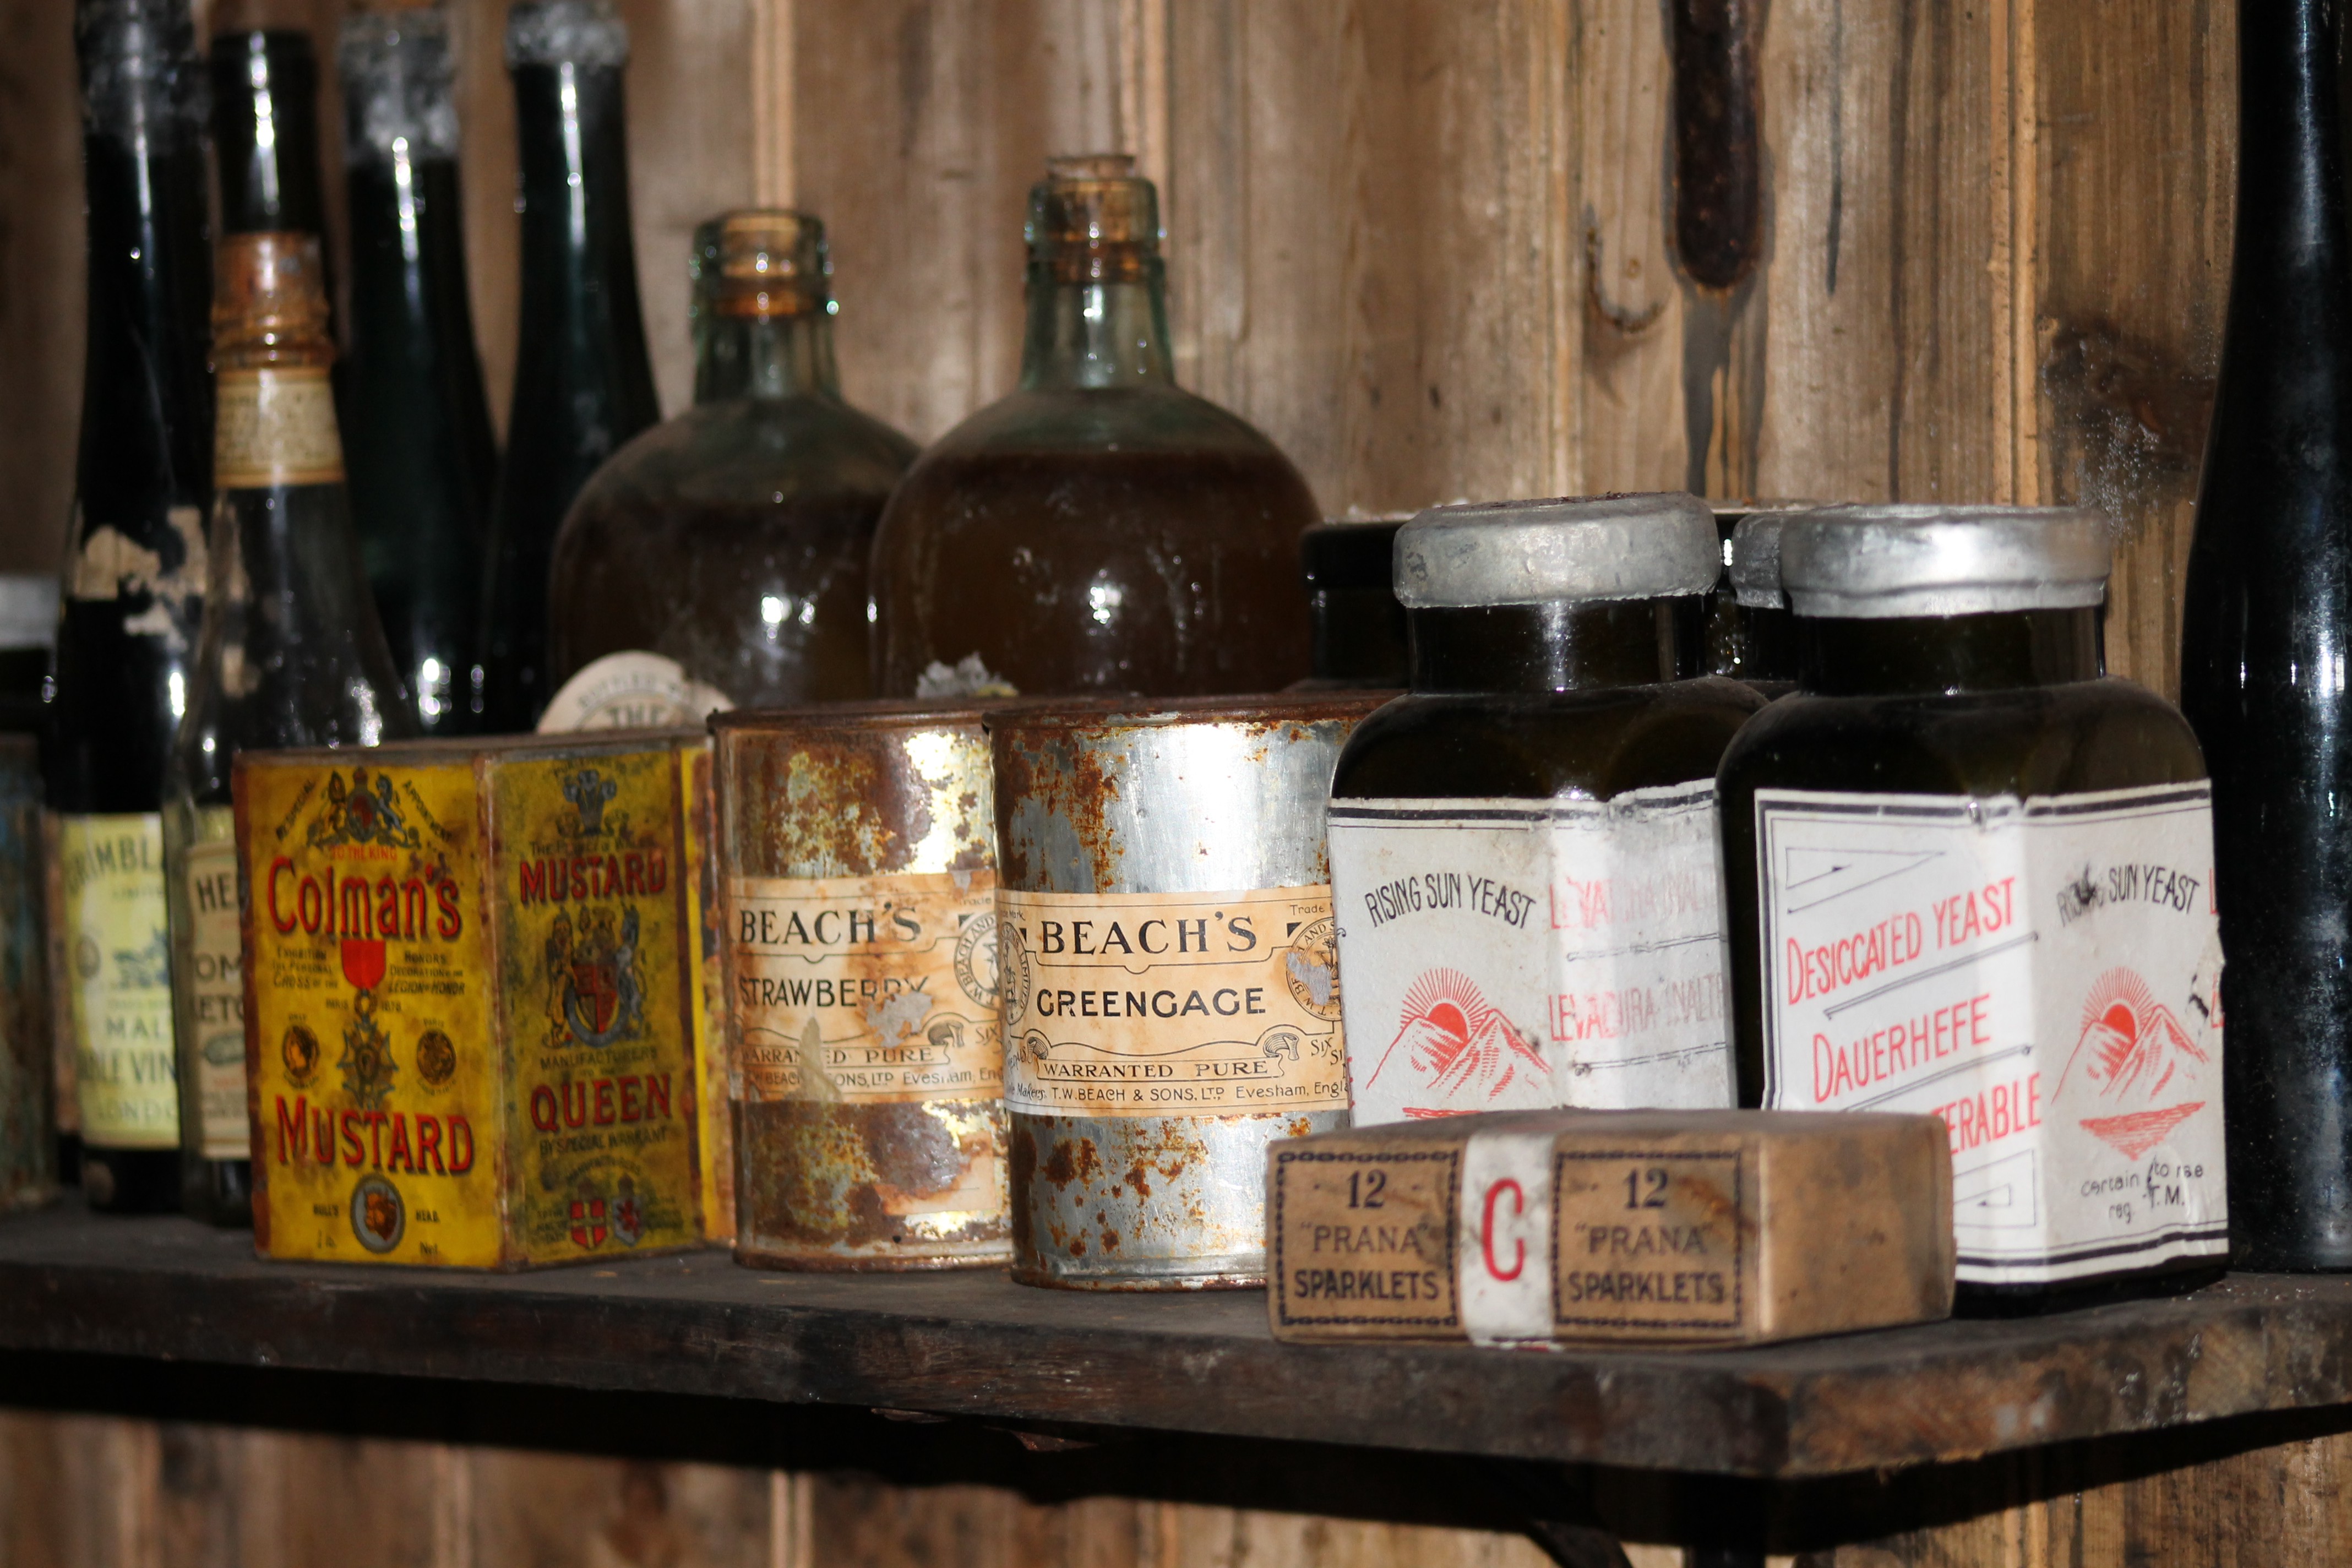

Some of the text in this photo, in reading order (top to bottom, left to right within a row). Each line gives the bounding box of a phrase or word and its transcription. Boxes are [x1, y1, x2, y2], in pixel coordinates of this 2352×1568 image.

[196, 873, 240, 913] HE
[268, 855, 462, 943] Colman's
[520, 852, 667, 907] MUSTARD
[1364, 873, 1537, 929] RISING SUN YEAST
[2108, 864, 2137, 903] SUN
[2143, 865, 2201, 915] YEAST
[741, 901, 922, 945] BEACH'S
[1290, 904, 1325, 916] Trade
[1041, 911, 1257, 955] BEACH'S
[1787, 876, 2016, 1005] DESICCATED YEAST
[1037, 987, 1266, 1019] GREENGAGE
[865, 1047, 934, 1064] PURE
[1043, 1060, 1268, 1079] WARRANTED PURE
[1813, 993, 1991, 1104] DAUERHEFE
[530, 1074, 672, 1134] QUEEN
[1133, 1089, 1144, 1101] &
[1236, 1084, 1309, 1099] Evesham,
[275, 1093, 476, 1176] MUSTARD
[1348, 1169, 1387, 1208] 12
[1625, 1167, 1668, 1209] 12
[1481, 1177, 1525, 1282] C
[1294, 1268, 1439, 1300] SPARKLETS
[1568, 1269, 1724, 1304] SPARKLETS
